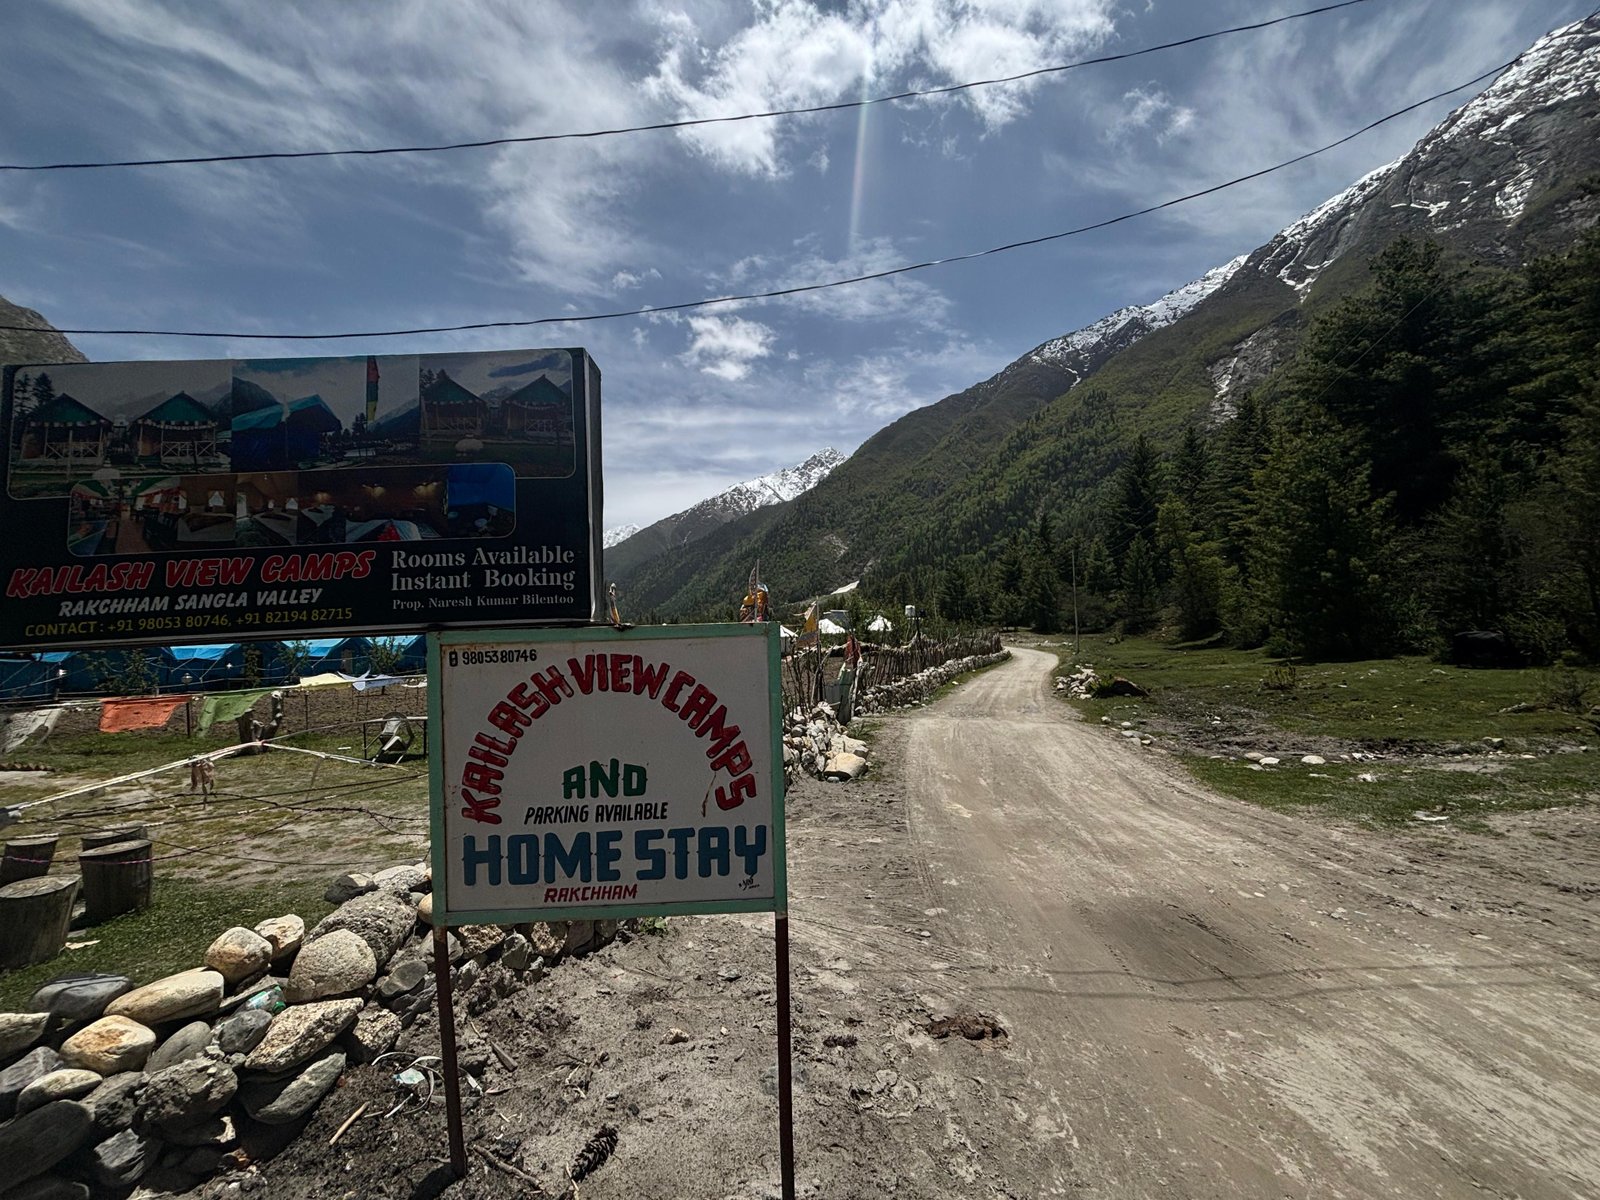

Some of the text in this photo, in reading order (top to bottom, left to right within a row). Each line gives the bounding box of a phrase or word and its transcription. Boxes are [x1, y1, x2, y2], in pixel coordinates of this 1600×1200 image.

[391, 545, 575, 569] Rooms Available
[6, 550, 376, 598] KAILASH VIEW CAMPS
[391, 567, 576, 591] Instant Booking
[58, 588, 323, 617] RAKCHHAM SANGLA VALLEY
[392, 599, 425, 611] Prop.
[428, 596, 472, 608] Naresh
[476, 595, 519, 606] Kumar
[107, 619, 134, 633] +91
[138, 616, 182, 630] 98053
[235, 611, 261, 627] +91
[265, 610, 307, 625] 82194
[310, 607, 353, 621] 82715
[461, 653, 758, 826] KAILASH VIEW CAMPS
[562, 758, 649, 800] AND
[523, 801, 669, 826] PARKING AVAILABLE
[543, 884, 638, 903] RAKCHHAM
